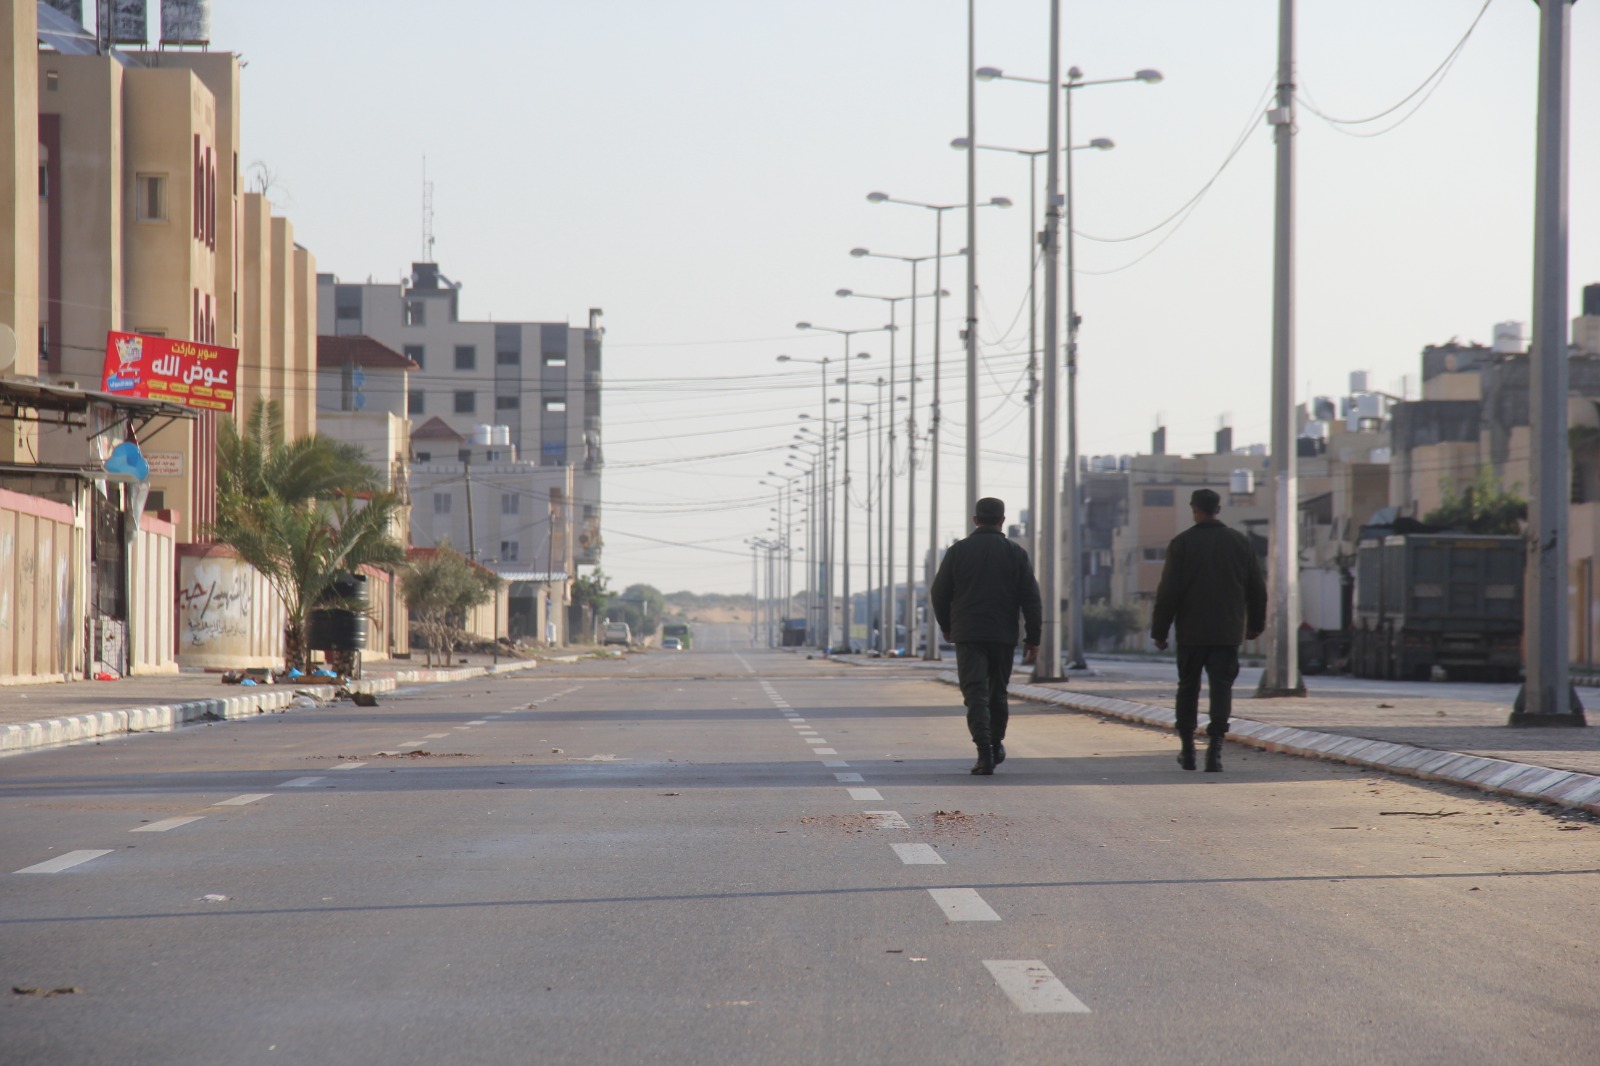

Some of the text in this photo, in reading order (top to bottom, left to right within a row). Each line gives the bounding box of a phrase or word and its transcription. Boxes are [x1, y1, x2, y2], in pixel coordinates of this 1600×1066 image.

[171, 342, 218, 360] سوبر ماركت
[152, 354, 228, 386] عوض الله
